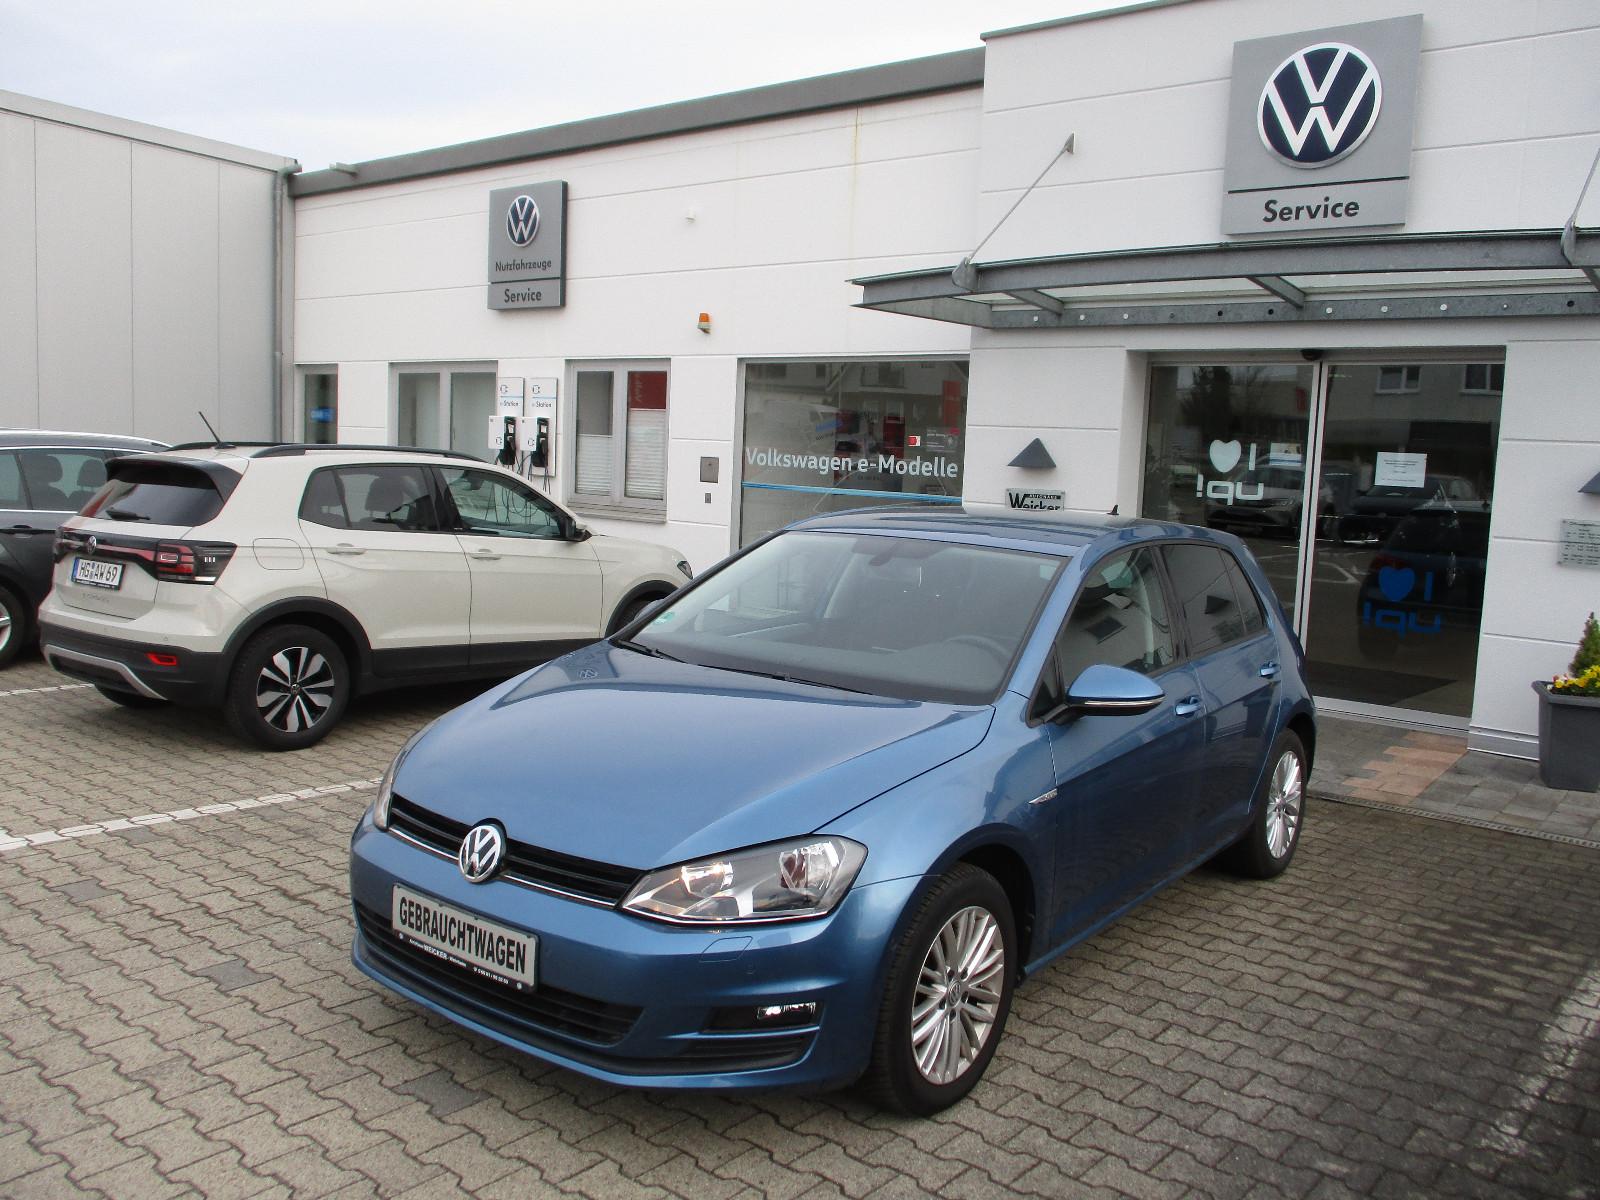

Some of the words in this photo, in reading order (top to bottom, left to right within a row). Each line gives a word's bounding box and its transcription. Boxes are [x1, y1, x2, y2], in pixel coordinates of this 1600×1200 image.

[1263, 197, 1360, 223] Service
[495, 259, 552, 272] Nutzfahrzeuge
[504, 288, 542, 303] Service
[745, 448, 852, 475] Volkswagen
[857, 454, 959, 478] e-Modelle
[399, 896, 527, 974] GEBRAUCHTWAGEN
